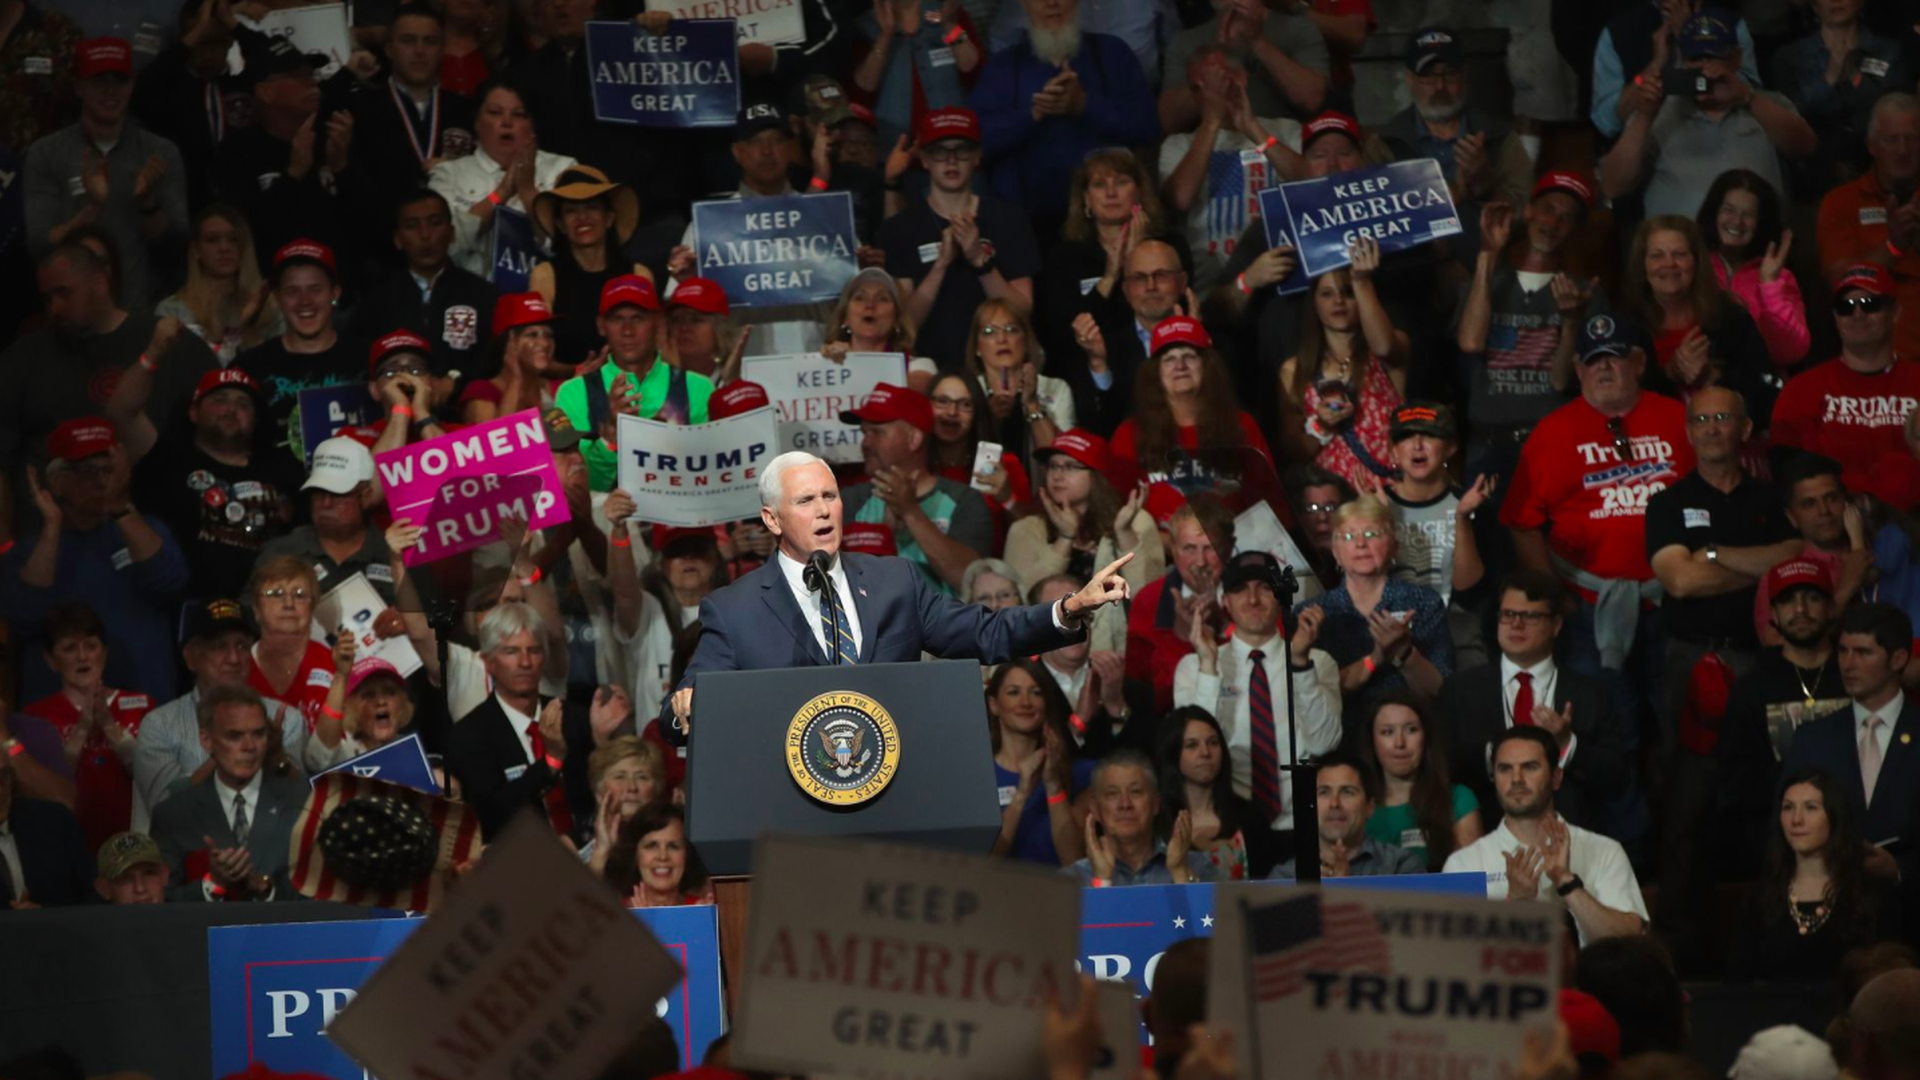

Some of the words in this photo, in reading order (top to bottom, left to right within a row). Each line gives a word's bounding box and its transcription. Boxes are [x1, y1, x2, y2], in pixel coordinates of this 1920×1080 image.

[633, 35, 688, 53] KEEP
[595, 60, 734, 85] AMERICA
[631, 94, 697, 111] GREAT
[746, 103, 780, 120] USA
[1333, 176, 1390, 199] KEEP
[745, 210, 801, 231] KEEP
[1300, 187, 1446, 236] AMERICA
[1342, 217, 1412, 247] GREAT
[703, 233, 850, 268] AMERICA
[744, 270, 813, 292] GREAT
[219, 370, 250, 384] USA
[797, 369, 851, 388] KEEP
[776, 393, 872, 423] MERI
[1824, 393, 1918, 419] TRUMP
[379, 417, 546, 488] WOMEN
[792, 429, 860, 449] GREAT
[633, 443, 766, 472] TRUMP
[441, 473, 500, 504] FOR
[645, 468, 756, 486] PENCE
[640, 487, 662, 496] MAKE
[705, 487, 732, 497] GREAT
[415, 490, 556, 555] TRUMP
[840, 696, 852, 704] OF
[854, 698, 869, 709] THE
[790, 696, 837, 747] PRESIDENT
[871, 706, 897, 753] UNITED
[795, 769, 806, 780] OF
[806, 777, 836, 800] SEAL
[855, 762, 893, 799] STATES
[864, 880, 979, 925] KEEP
[1376, 908, 1550, 942] VETERANS
[425, 904, 505, 993] KEEP
[1480, 948, 1548, 976] FOR
[759, 927, 1063, 1010] AMERICA
[1305, 972, 1548, 1022] TRUMP
[833, 1006, 977, 1058] GREAT
